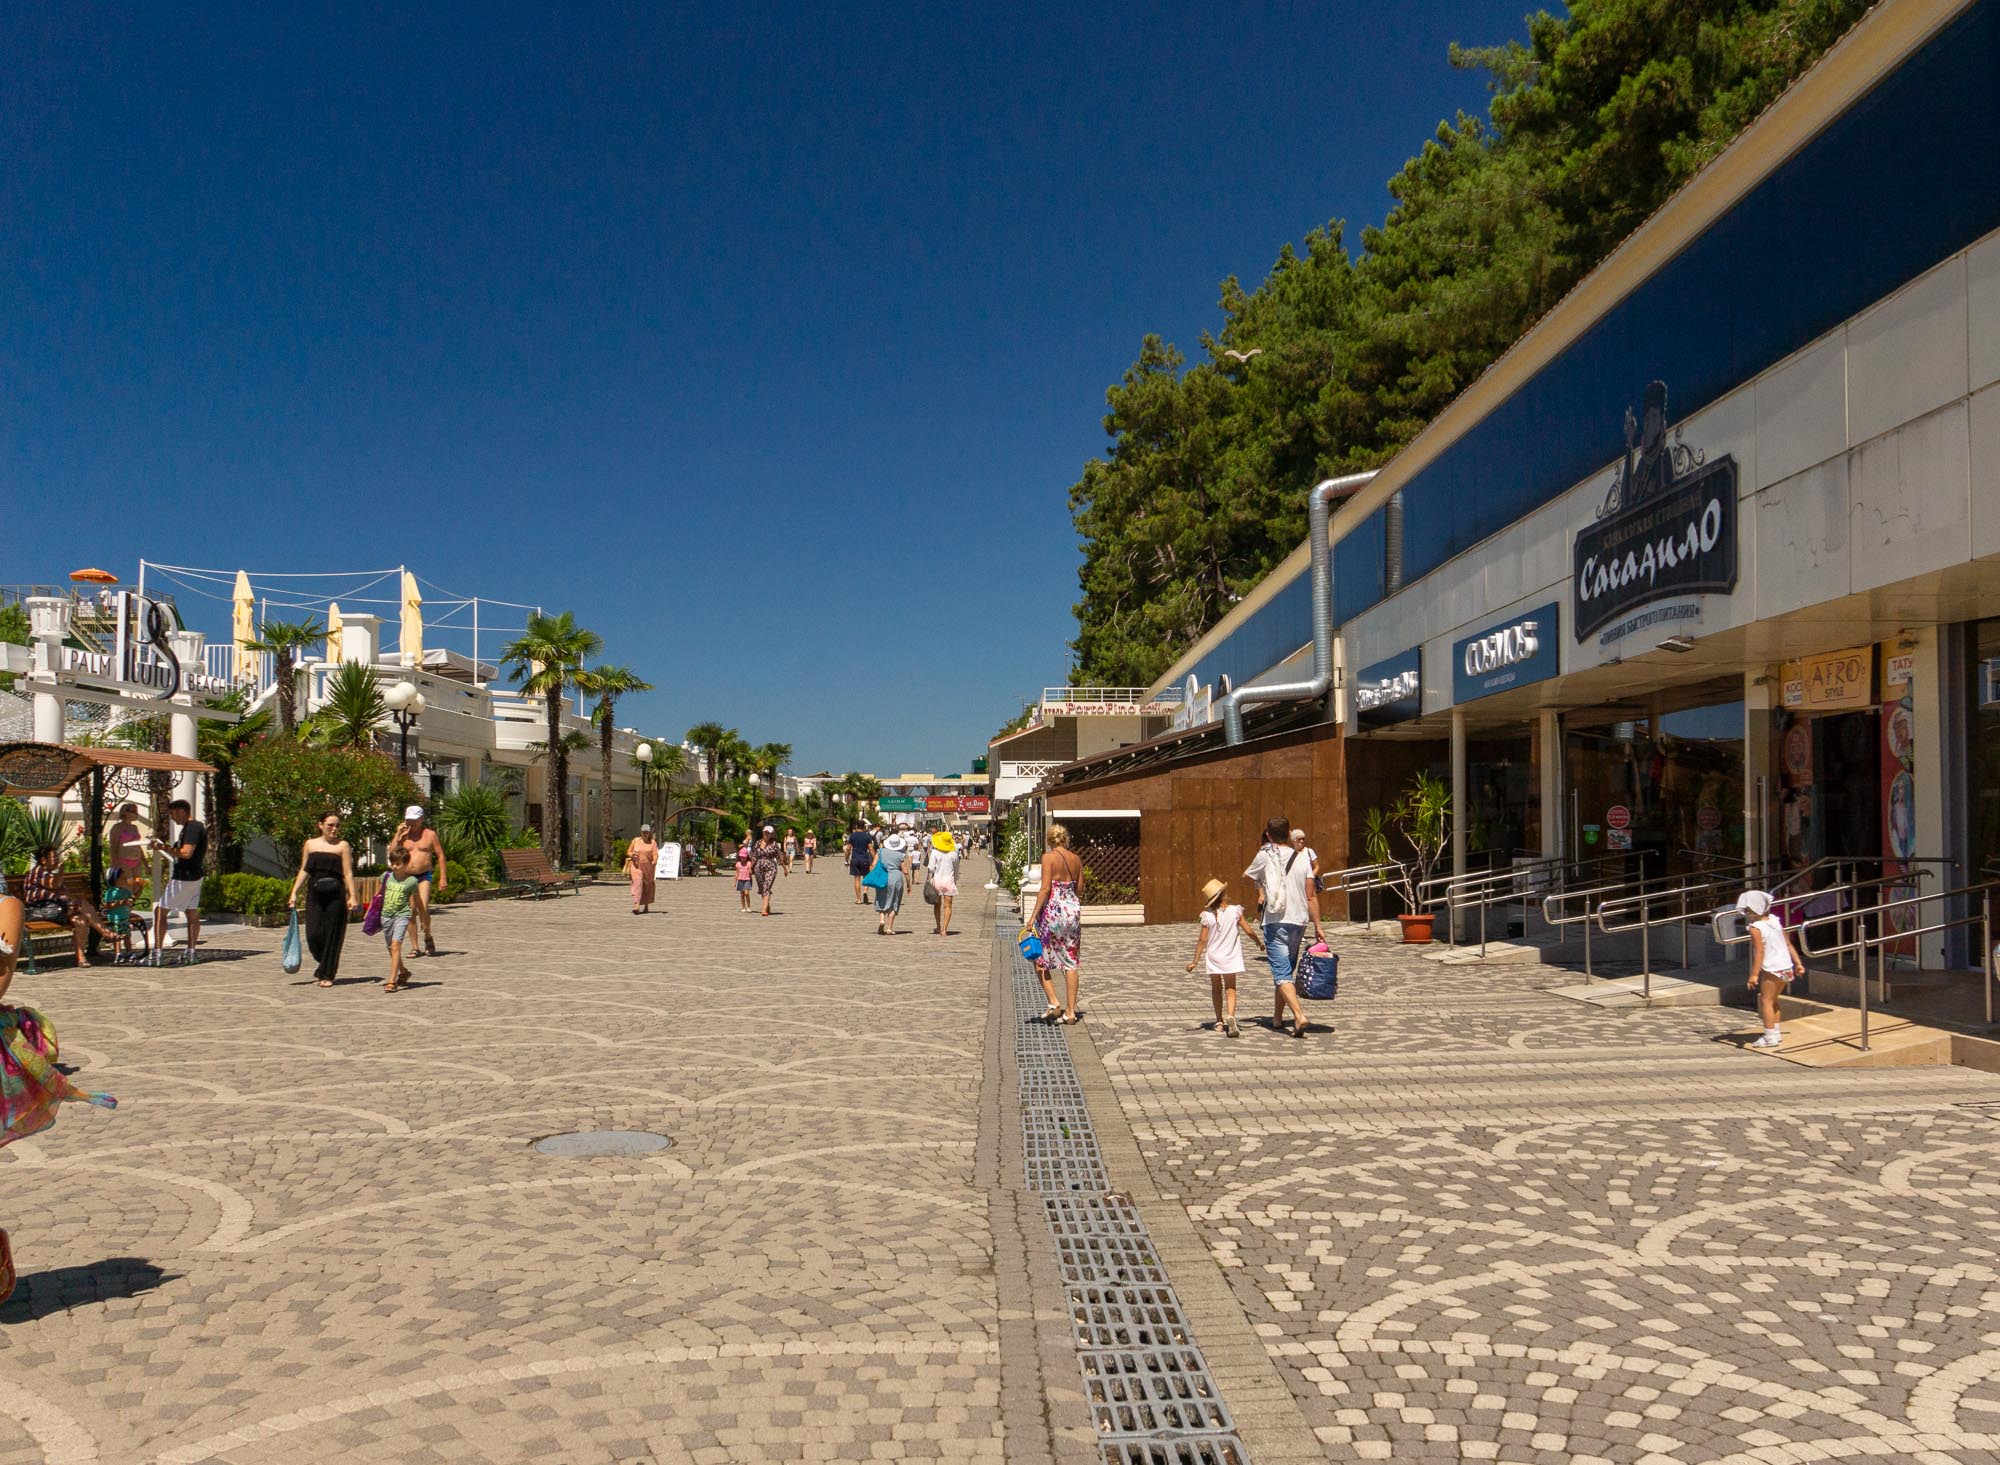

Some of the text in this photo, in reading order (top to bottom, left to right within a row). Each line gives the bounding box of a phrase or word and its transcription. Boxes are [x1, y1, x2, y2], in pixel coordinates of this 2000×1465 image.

[1465, 621, 1539, 677] COSMOS
[70, 649, 111, 677] PALM
[188, 673, 227, 697] BEACH
[1811, 658, 1860, 688] AFRO
[1824, 687, 1844, 698] STYLE
[391, 742, 417, 758] ZERA
